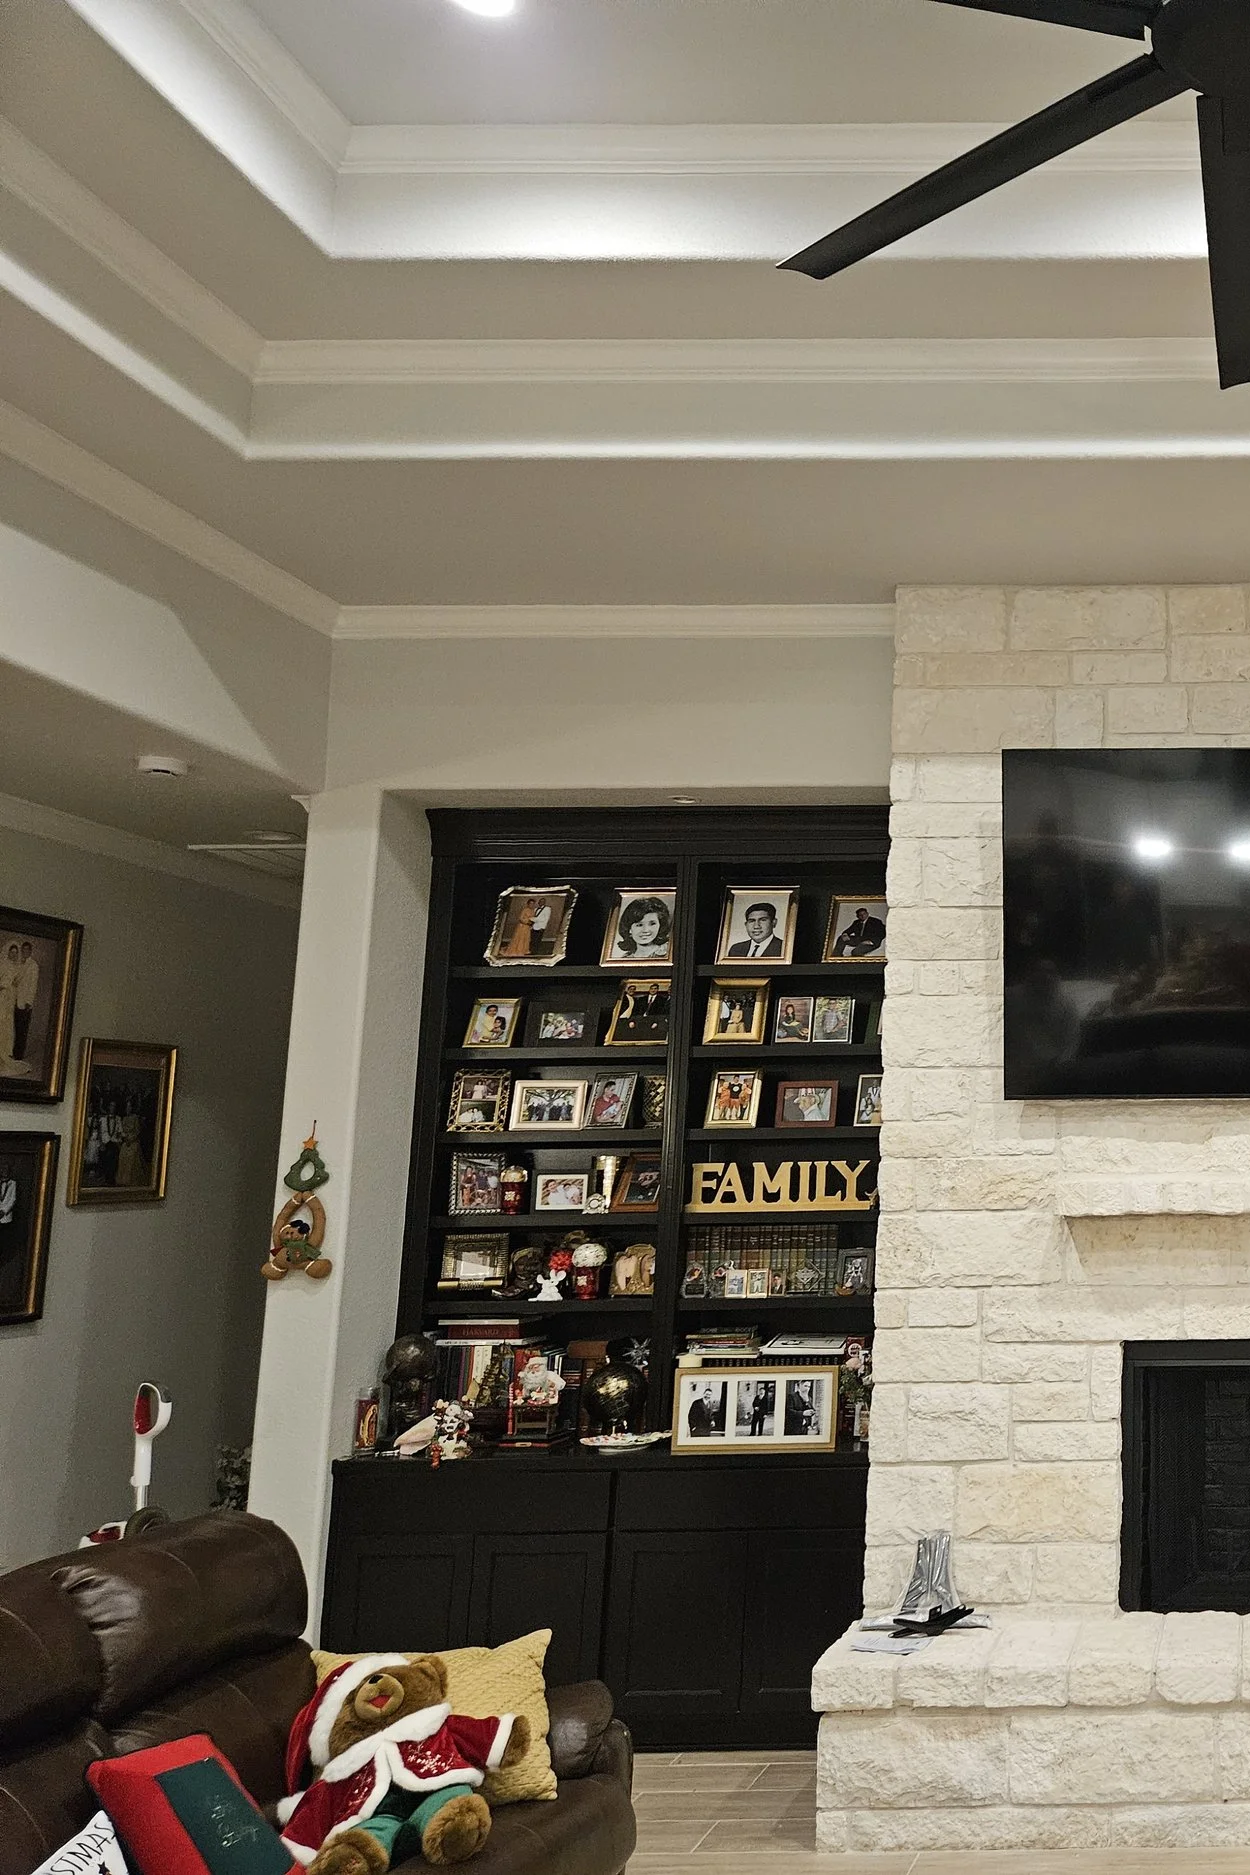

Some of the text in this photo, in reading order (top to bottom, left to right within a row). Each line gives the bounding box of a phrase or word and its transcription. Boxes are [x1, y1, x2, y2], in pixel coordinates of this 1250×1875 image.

[689, 1160, 871, 1209] FAMILY
[462, 1327, 499, 1337] HARVARD
[44, 1823, 116, 1875] STMAS
